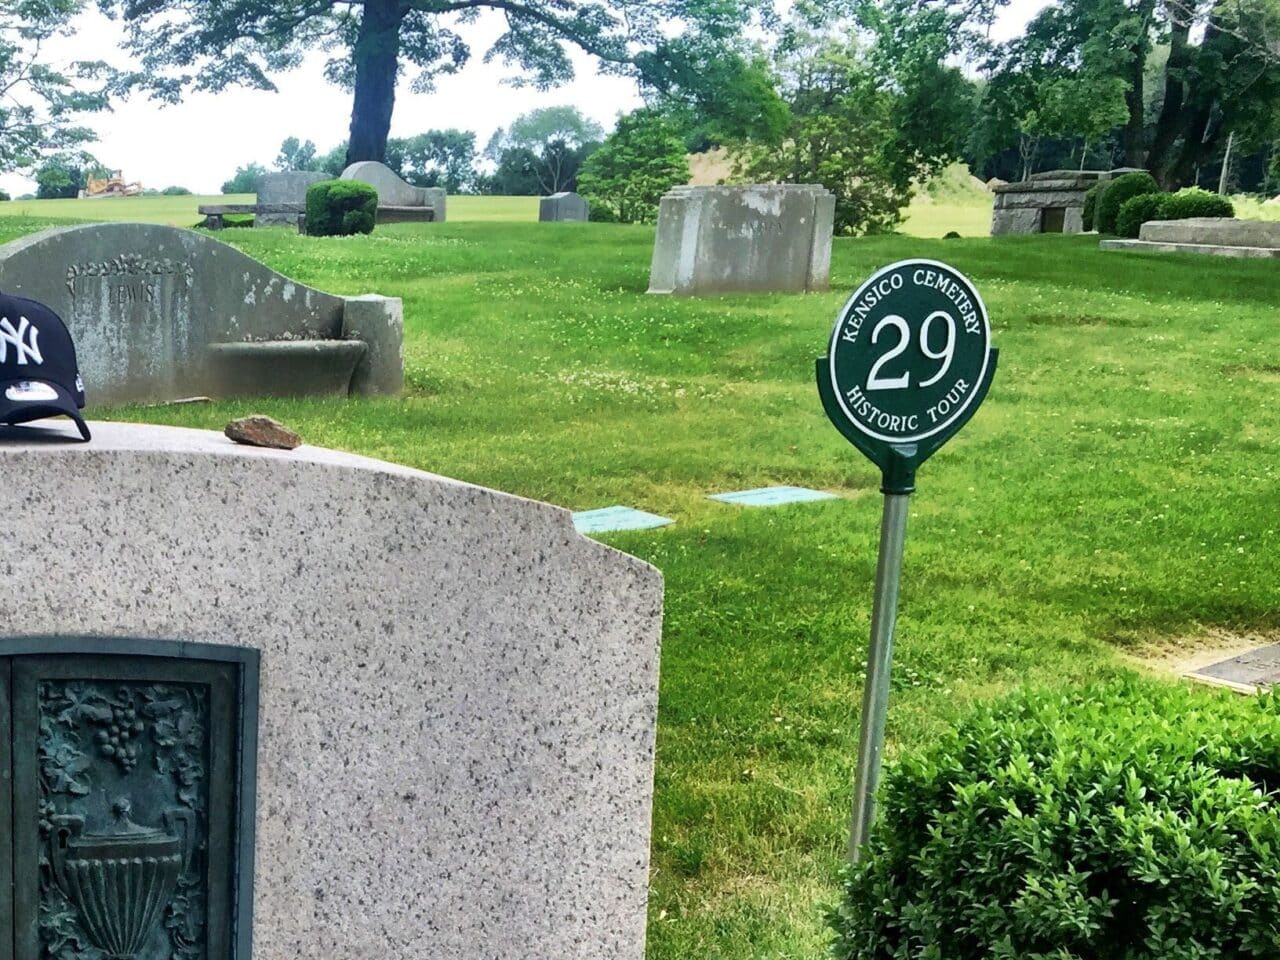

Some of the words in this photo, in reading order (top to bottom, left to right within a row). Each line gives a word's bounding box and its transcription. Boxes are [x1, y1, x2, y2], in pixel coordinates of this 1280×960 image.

[108, 283, 155, 304] LEWIS
[842, 273, 904, 343] KENSICO
[913, 269, 981, 336] CEMETERY
[866, 310, 956, 391] 29
[846, 384, 919, 432] HISTORIC
[926, 378, 970, 423] TOUR
